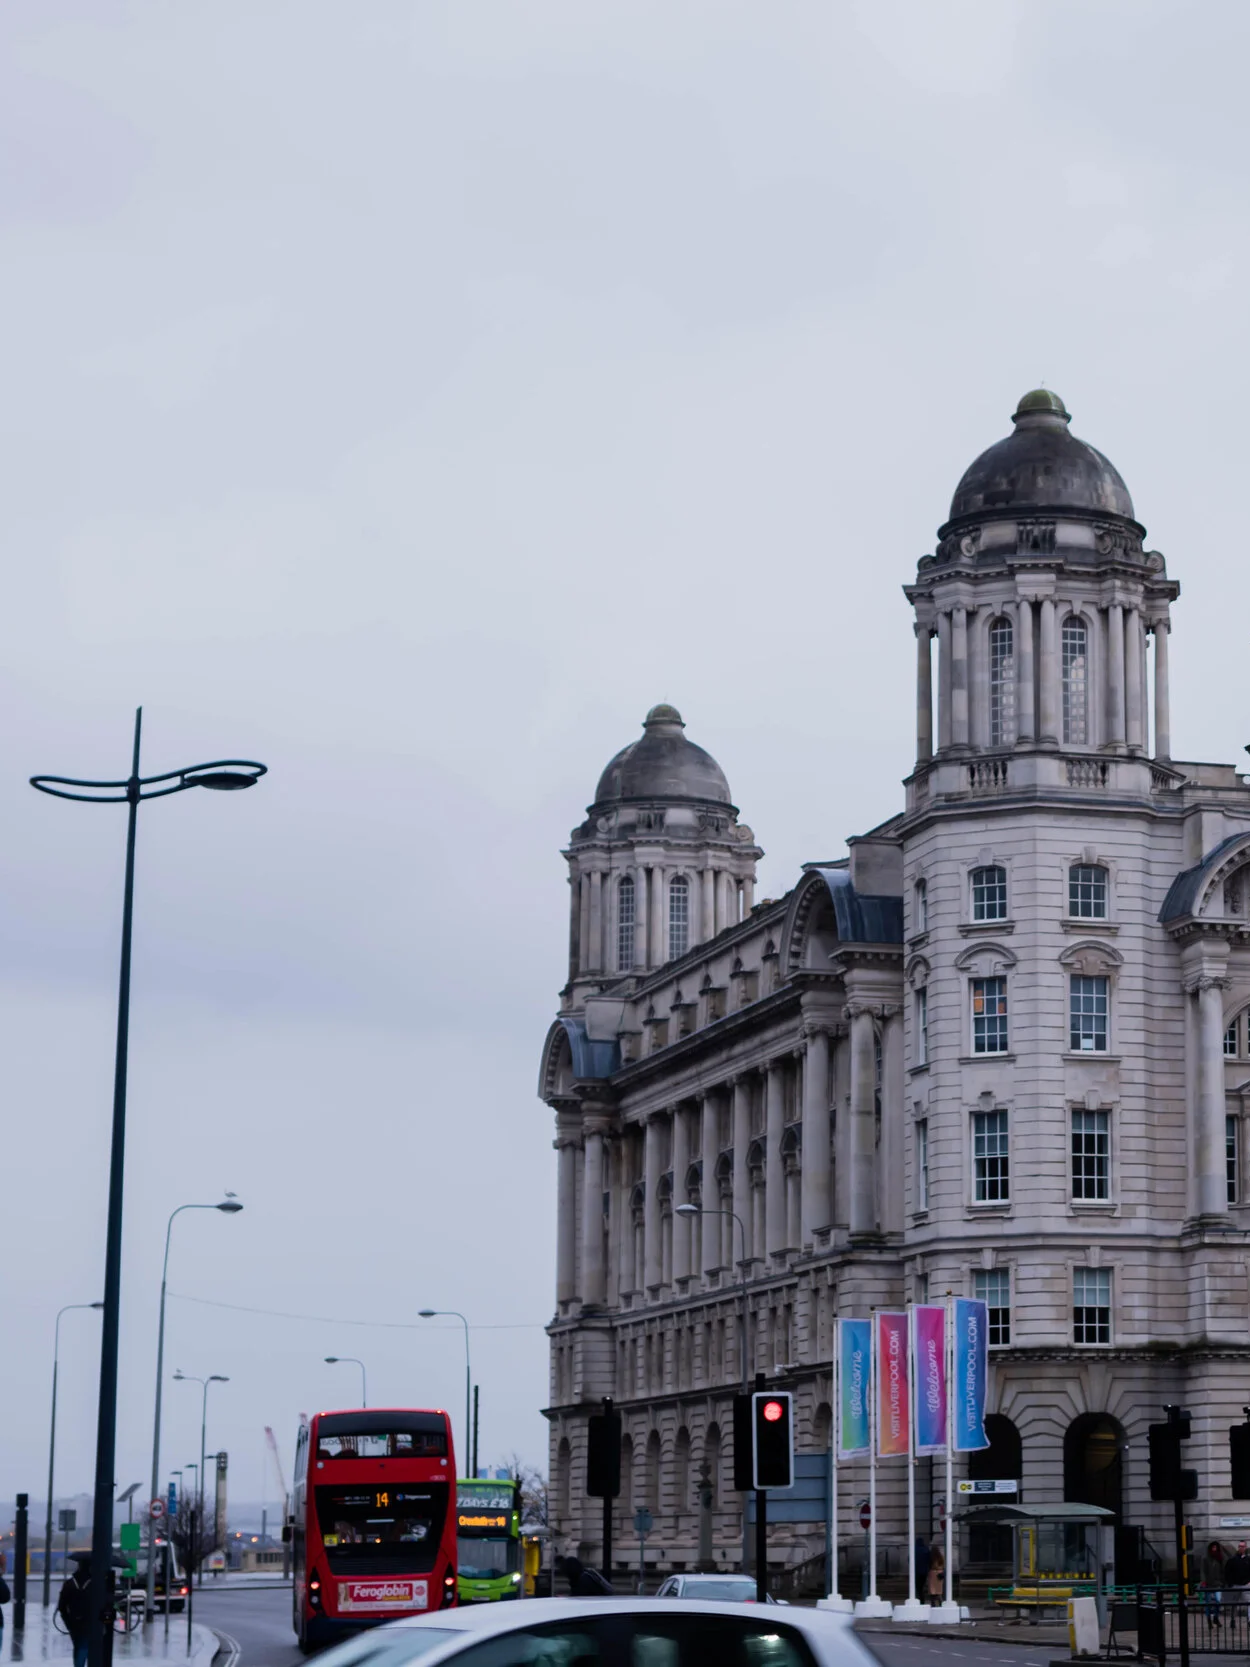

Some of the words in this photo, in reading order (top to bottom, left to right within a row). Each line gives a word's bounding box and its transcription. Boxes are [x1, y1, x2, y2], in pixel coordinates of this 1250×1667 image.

[851, 1350, 862, 1420] Welcome
[889, 1330, 900, 1439] VISITLIVERPOOL.COM
[926, 1339, 940, 1413] Welcome
[966, 1316, 977, 1431] VISITLIVERPOOL.COM
[376, 1492, 389, 1508] 14
[353, 1583, 410, 1600] Feroglobin
